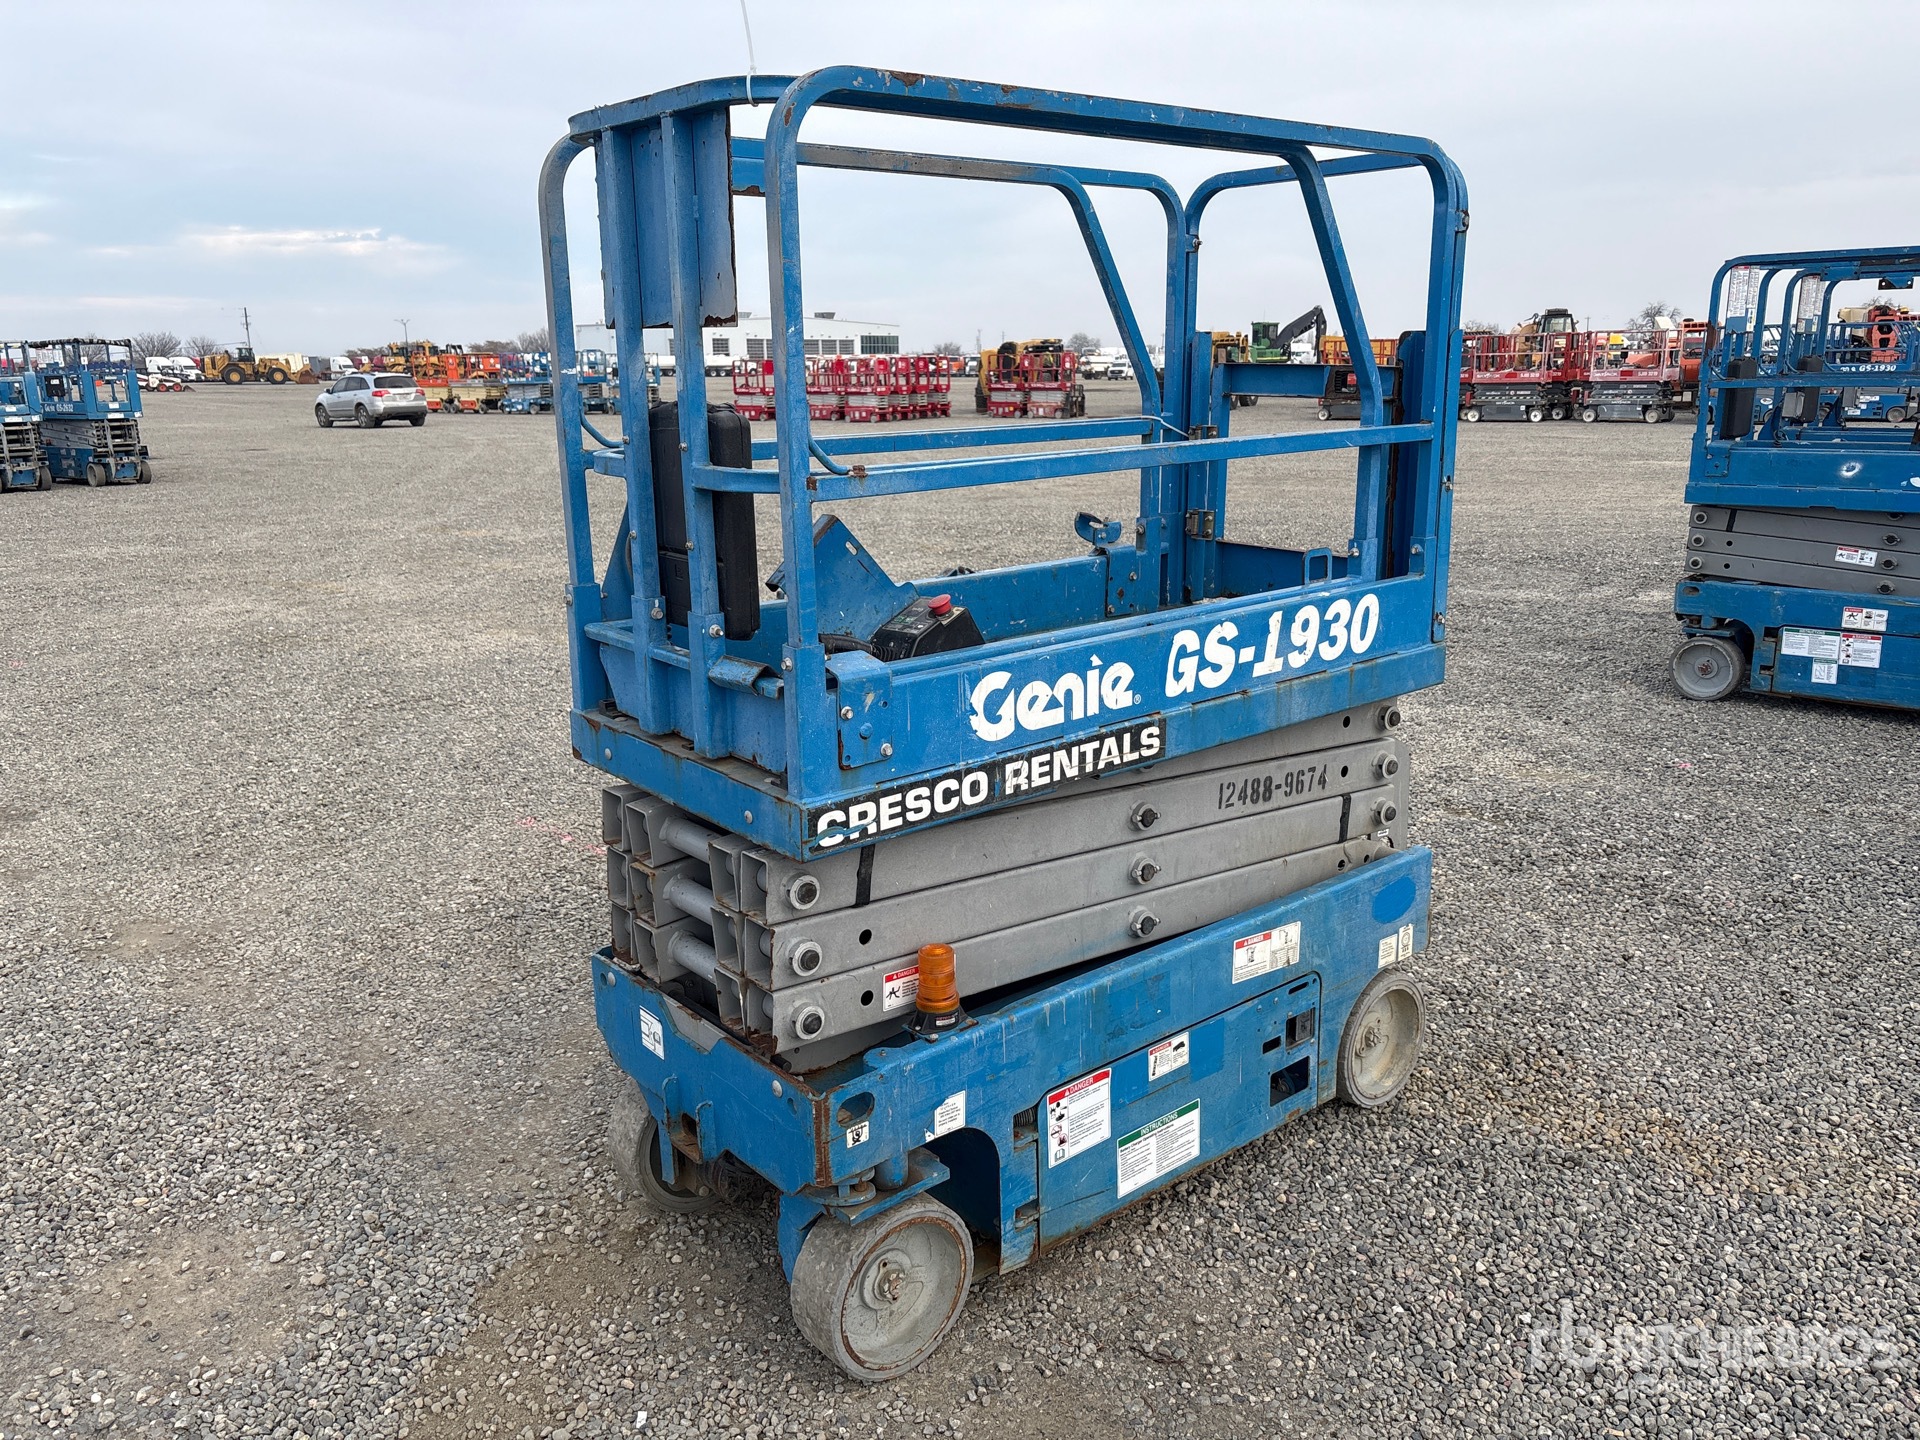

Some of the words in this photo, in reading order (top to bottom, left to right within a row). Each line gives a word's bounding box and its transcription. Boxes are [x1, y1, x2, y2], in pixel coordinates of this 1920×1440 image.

[1859, 364, 1897, 372] GS-1930
[969, 653, 1135, 742] Genie
[1164, 593, 1380, 698] GS-1930
[816, 770, 990, 848] CRESCO
[1004, 726, 1162, 796] RENTALS
[1218, 764, 1328, 809] 12488-9674
[1069, 1076, 1094, 1096] DANGER
[1140, 1111, 1179, 1137] INSTRUCTIONS
